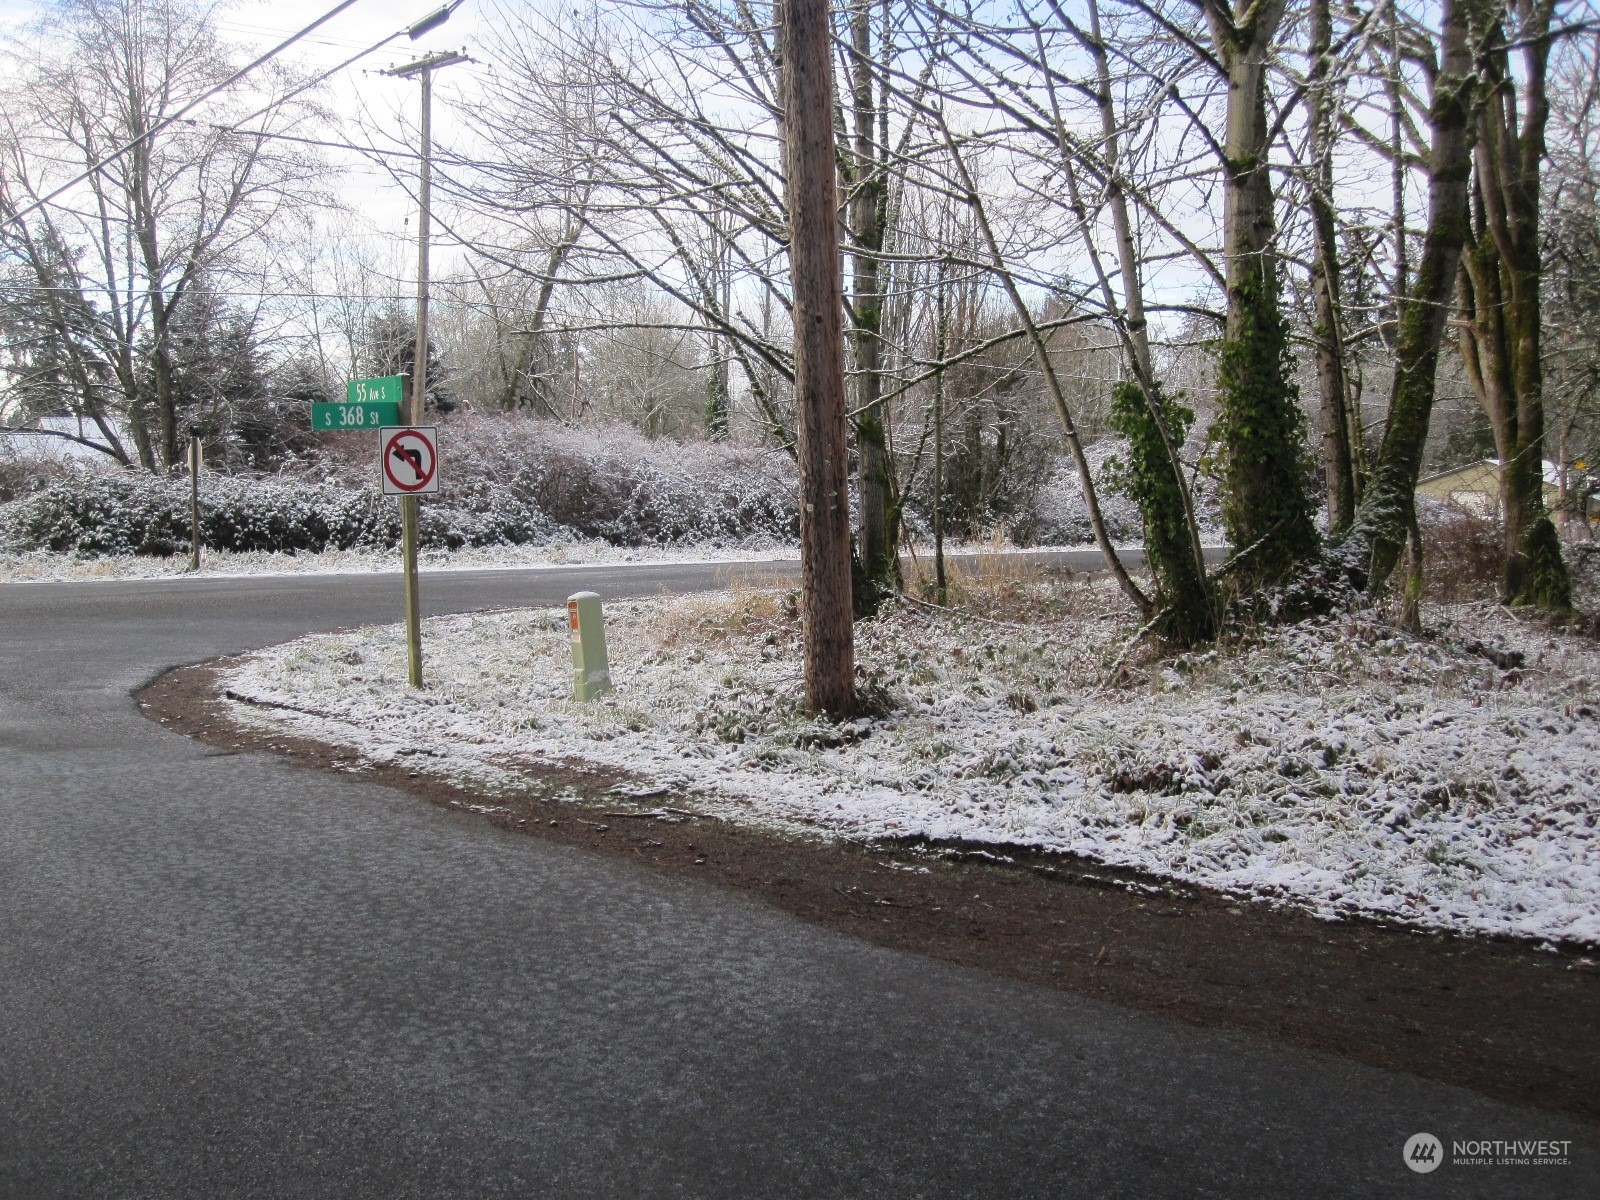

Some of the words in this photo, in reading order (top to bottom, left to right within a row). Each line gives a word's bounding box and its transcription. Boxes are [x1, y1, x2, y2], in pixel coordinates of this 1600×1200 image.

[356, 383, 366, 401] 55
[370, 388, 379, 400] Ave
[381, 386, 386, 400] S
[325, 412, 332, 426] S
[339, 405, 364, 426] 368
[370, 411, 379, 425] St
